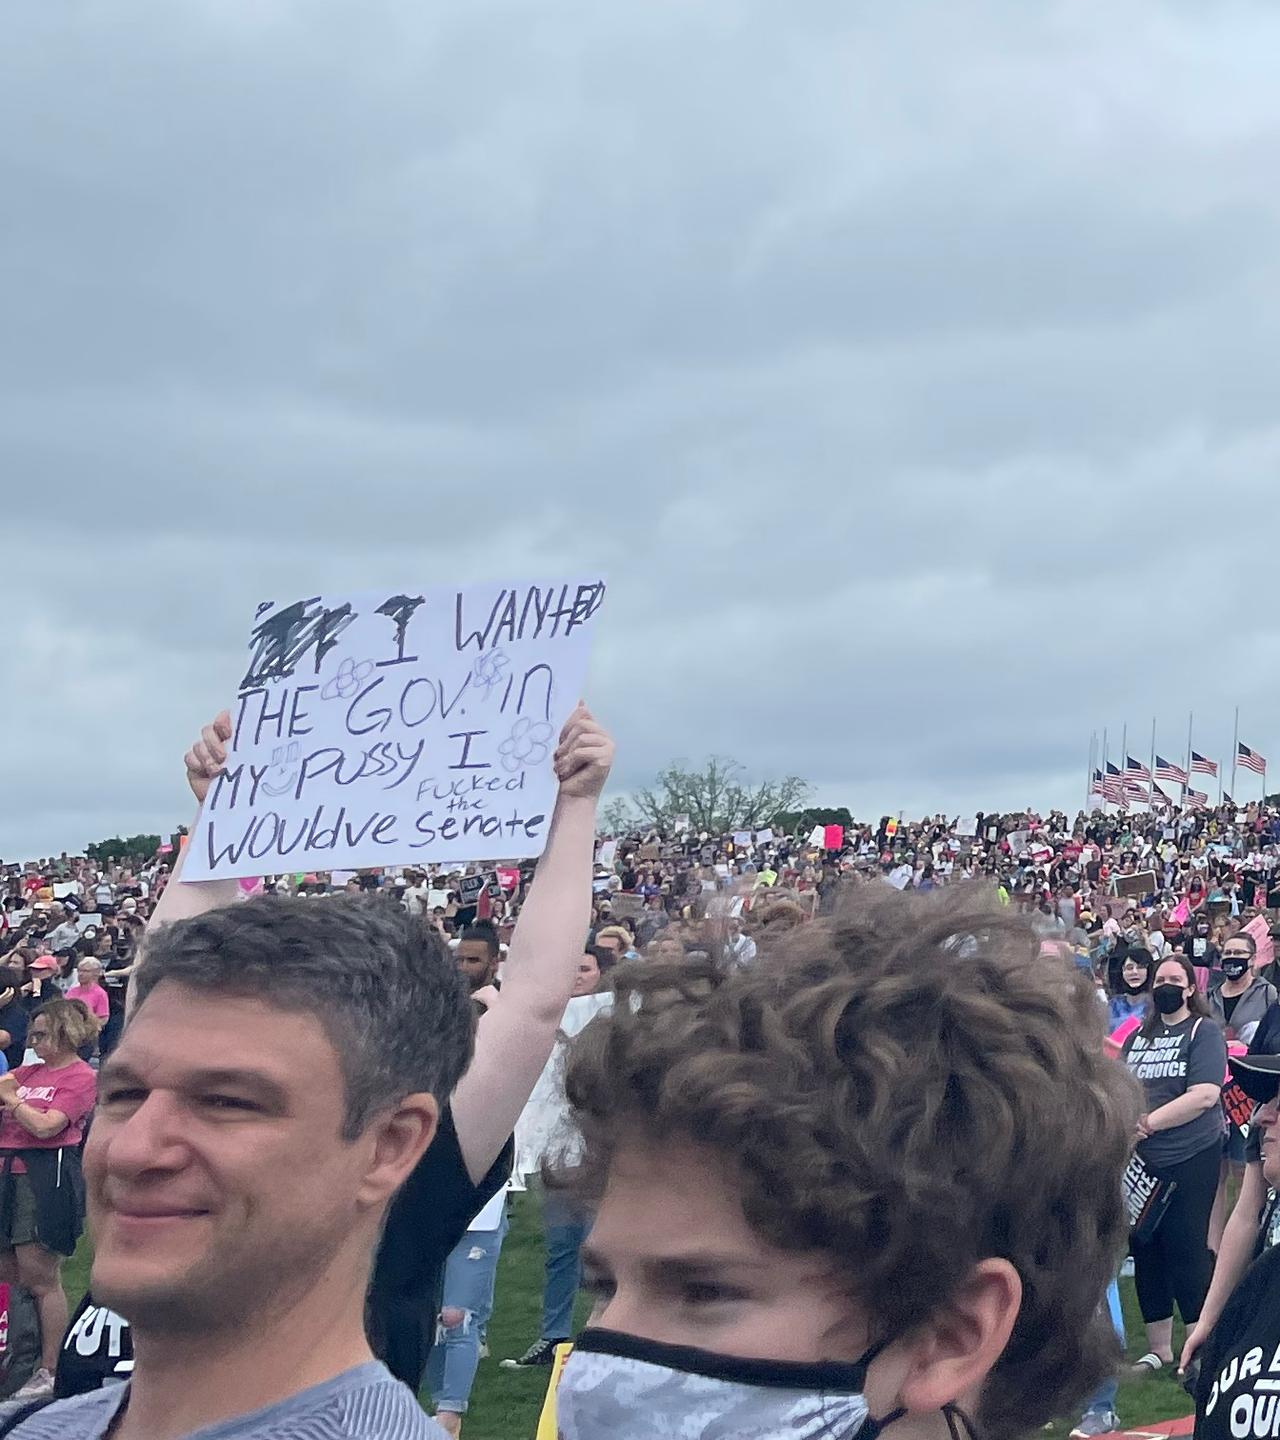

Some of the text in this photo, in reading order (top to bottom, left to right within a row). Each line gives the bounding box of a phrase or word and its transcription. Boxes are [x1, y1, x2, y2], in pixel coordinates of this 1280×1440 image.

[374, 594, 427, 667] I
[233, 685, 320, 752] THE
[346, 670, 473, 737] GOV.
[209, 730, 493, 811] MY PUSSY I
[446, 795, 489, 813] the
[1136, 1061, 1187, 1079] CHOICE
[1205, 1346, 1264, 1417] OUR
